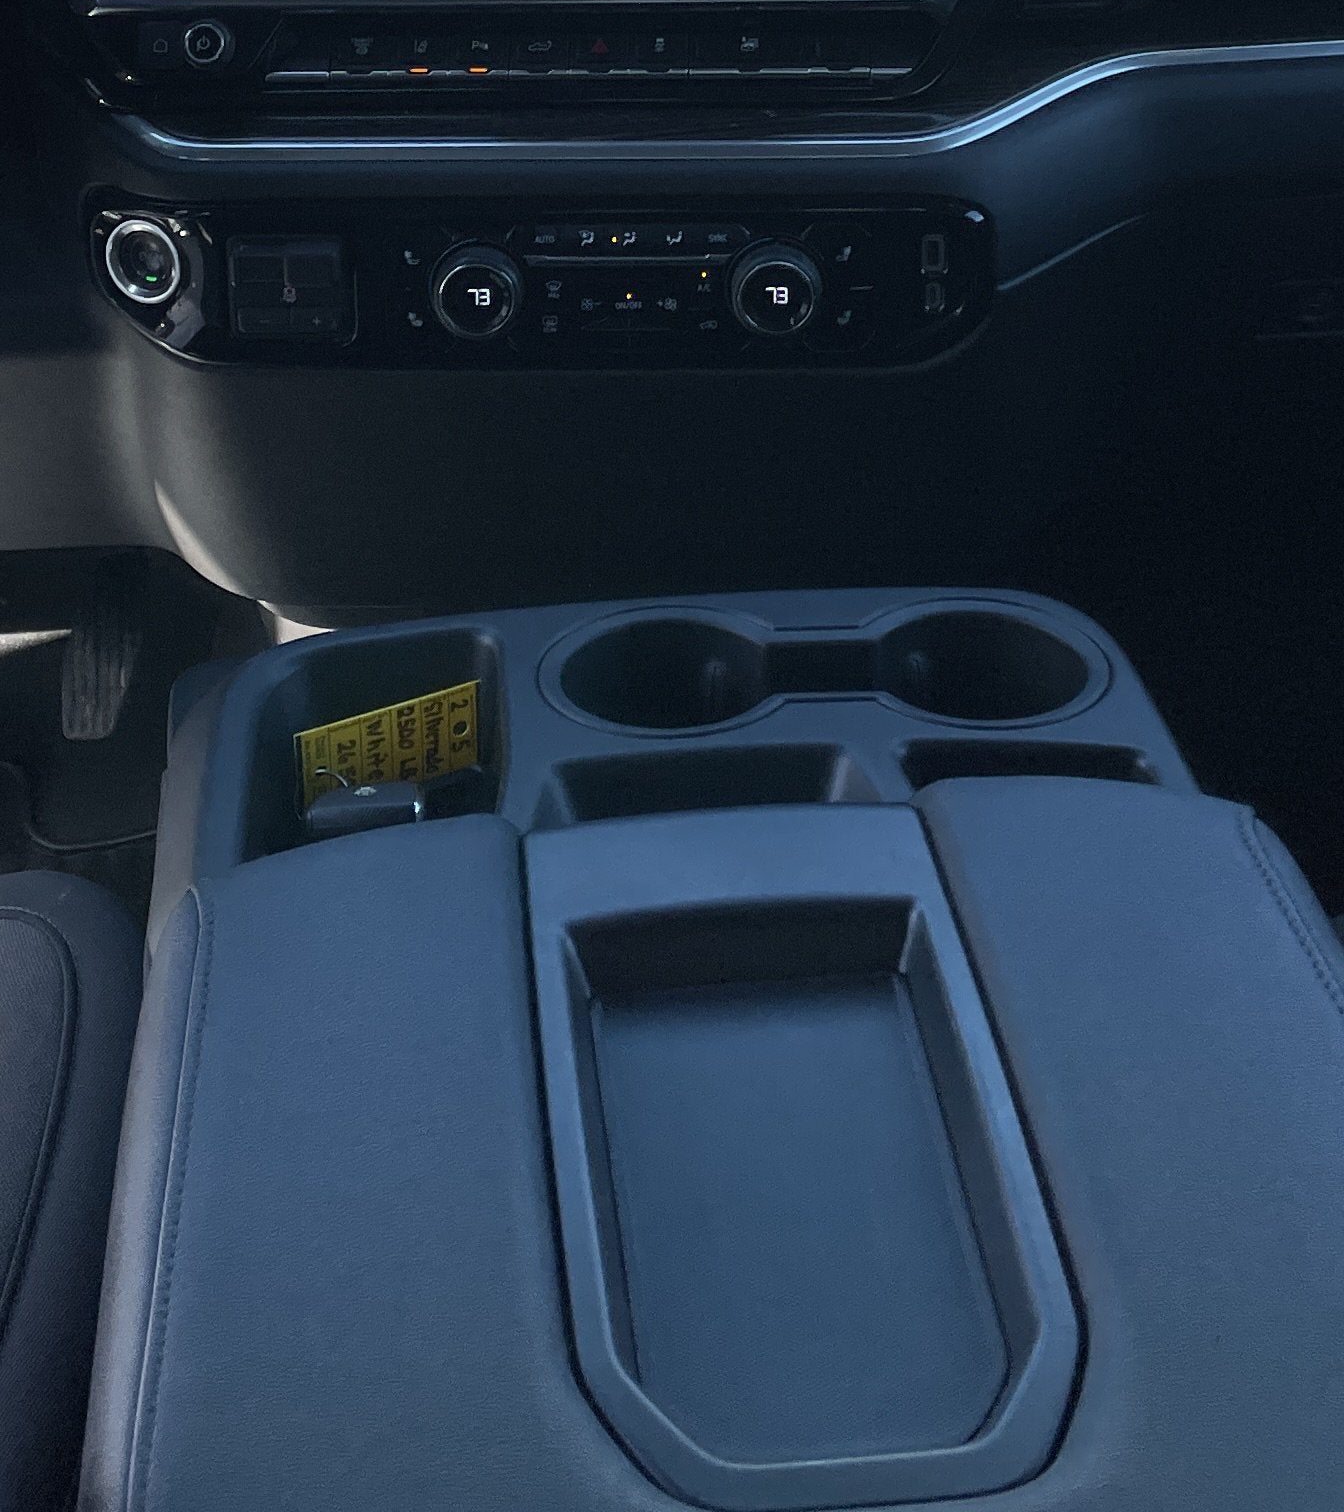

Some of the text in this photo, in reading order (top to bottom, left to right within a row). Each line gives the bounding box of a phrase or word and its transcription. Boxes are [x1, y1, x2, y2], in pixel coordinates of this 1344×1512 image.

[467, 288, 491, 306] 73
[765, 286, 789, 305] 73
[366, 718, 389, 782] White
